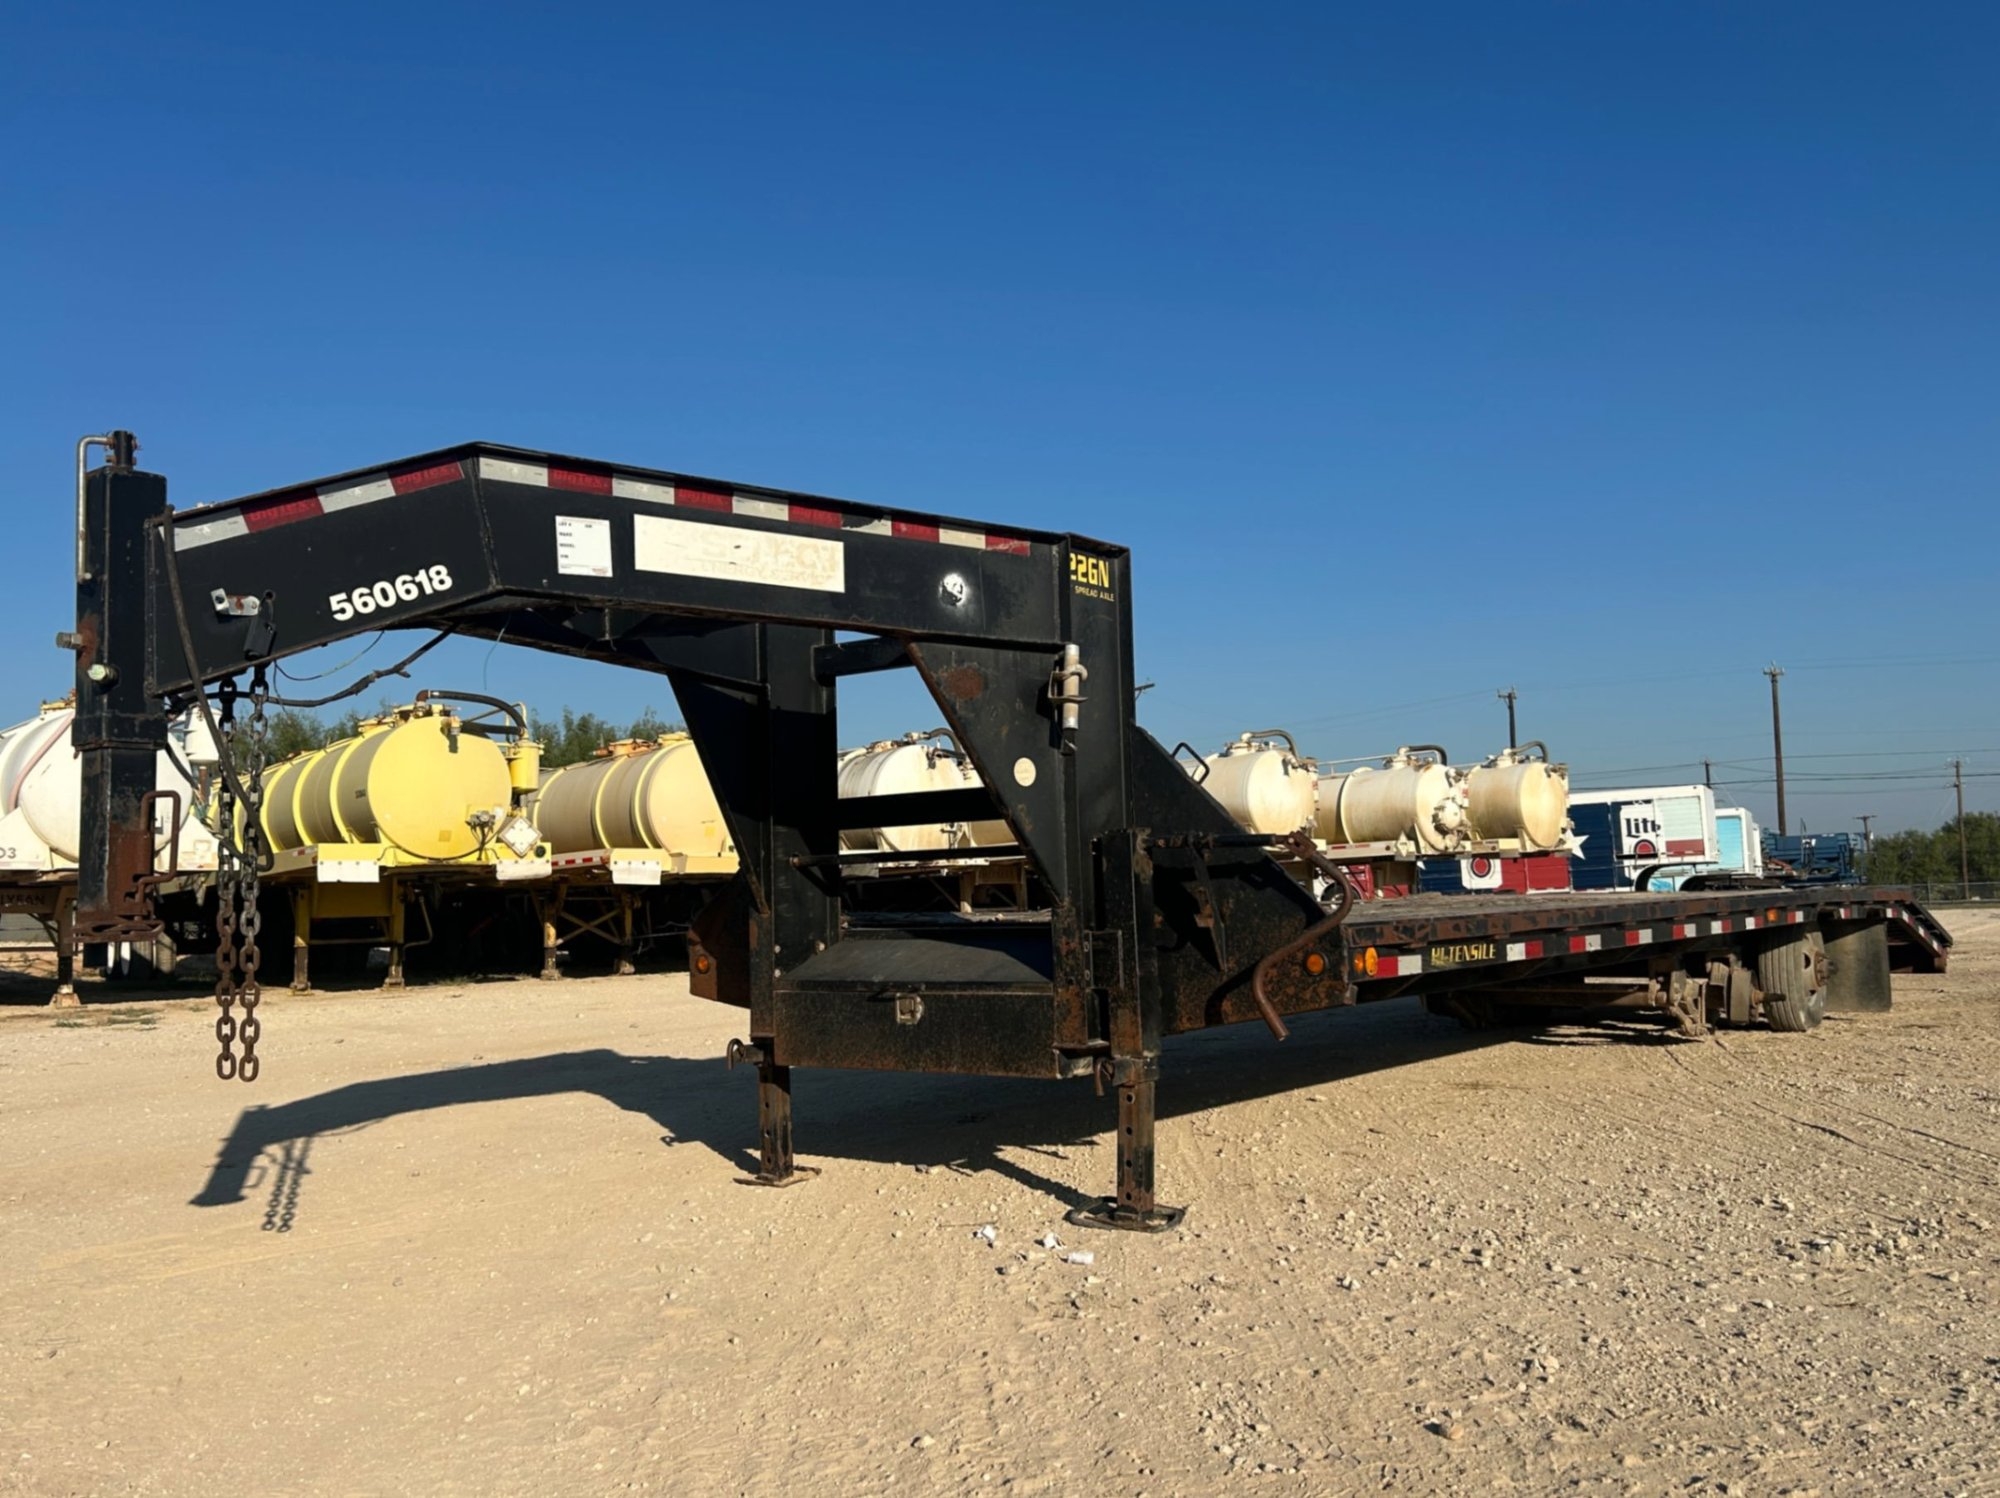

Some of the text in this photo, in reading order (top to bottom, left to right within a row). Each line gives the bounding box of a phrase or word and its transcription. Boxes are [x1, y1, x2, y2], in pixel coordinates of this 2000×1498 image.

[329, 564, 453, 622] 560618
[1075, 585, 1115, 602] SPREAD AXLE
